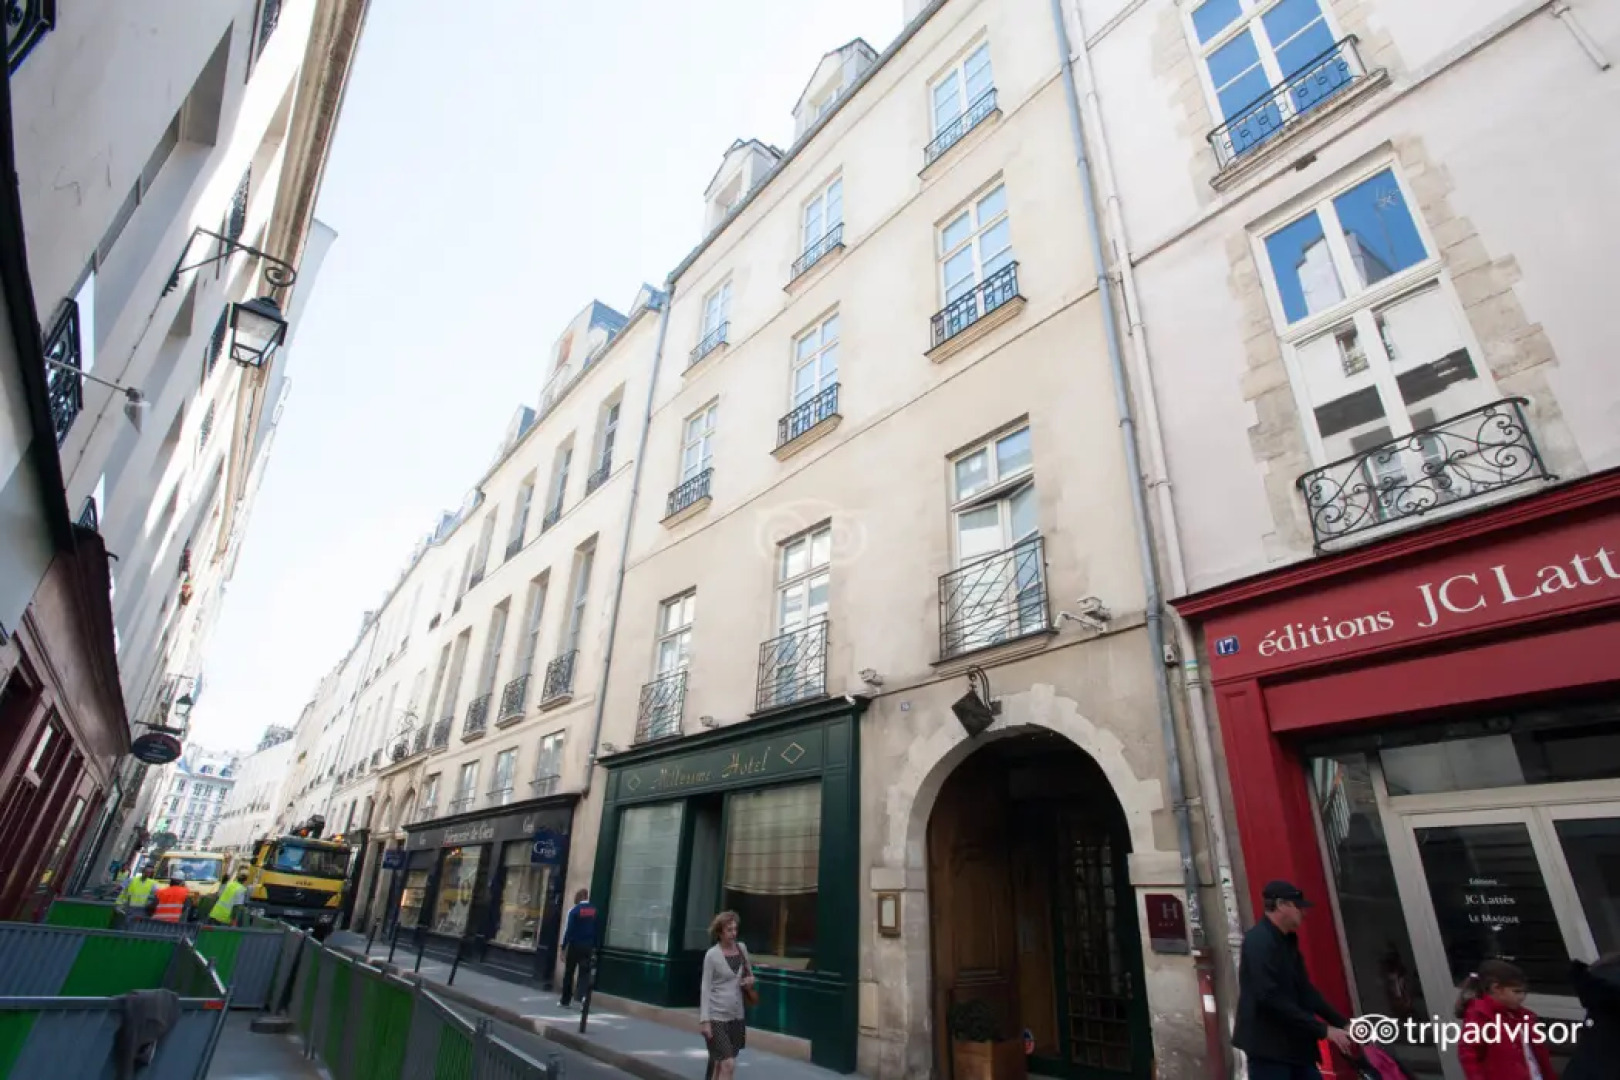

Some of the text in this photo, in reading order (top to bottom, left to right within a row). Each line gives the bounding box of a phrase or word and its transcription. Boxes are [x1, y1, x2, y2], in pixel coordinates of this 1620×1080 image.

[1258, 546, 1620, 657] éditions JC Latt
[1162, 902, 1178, 919] H
